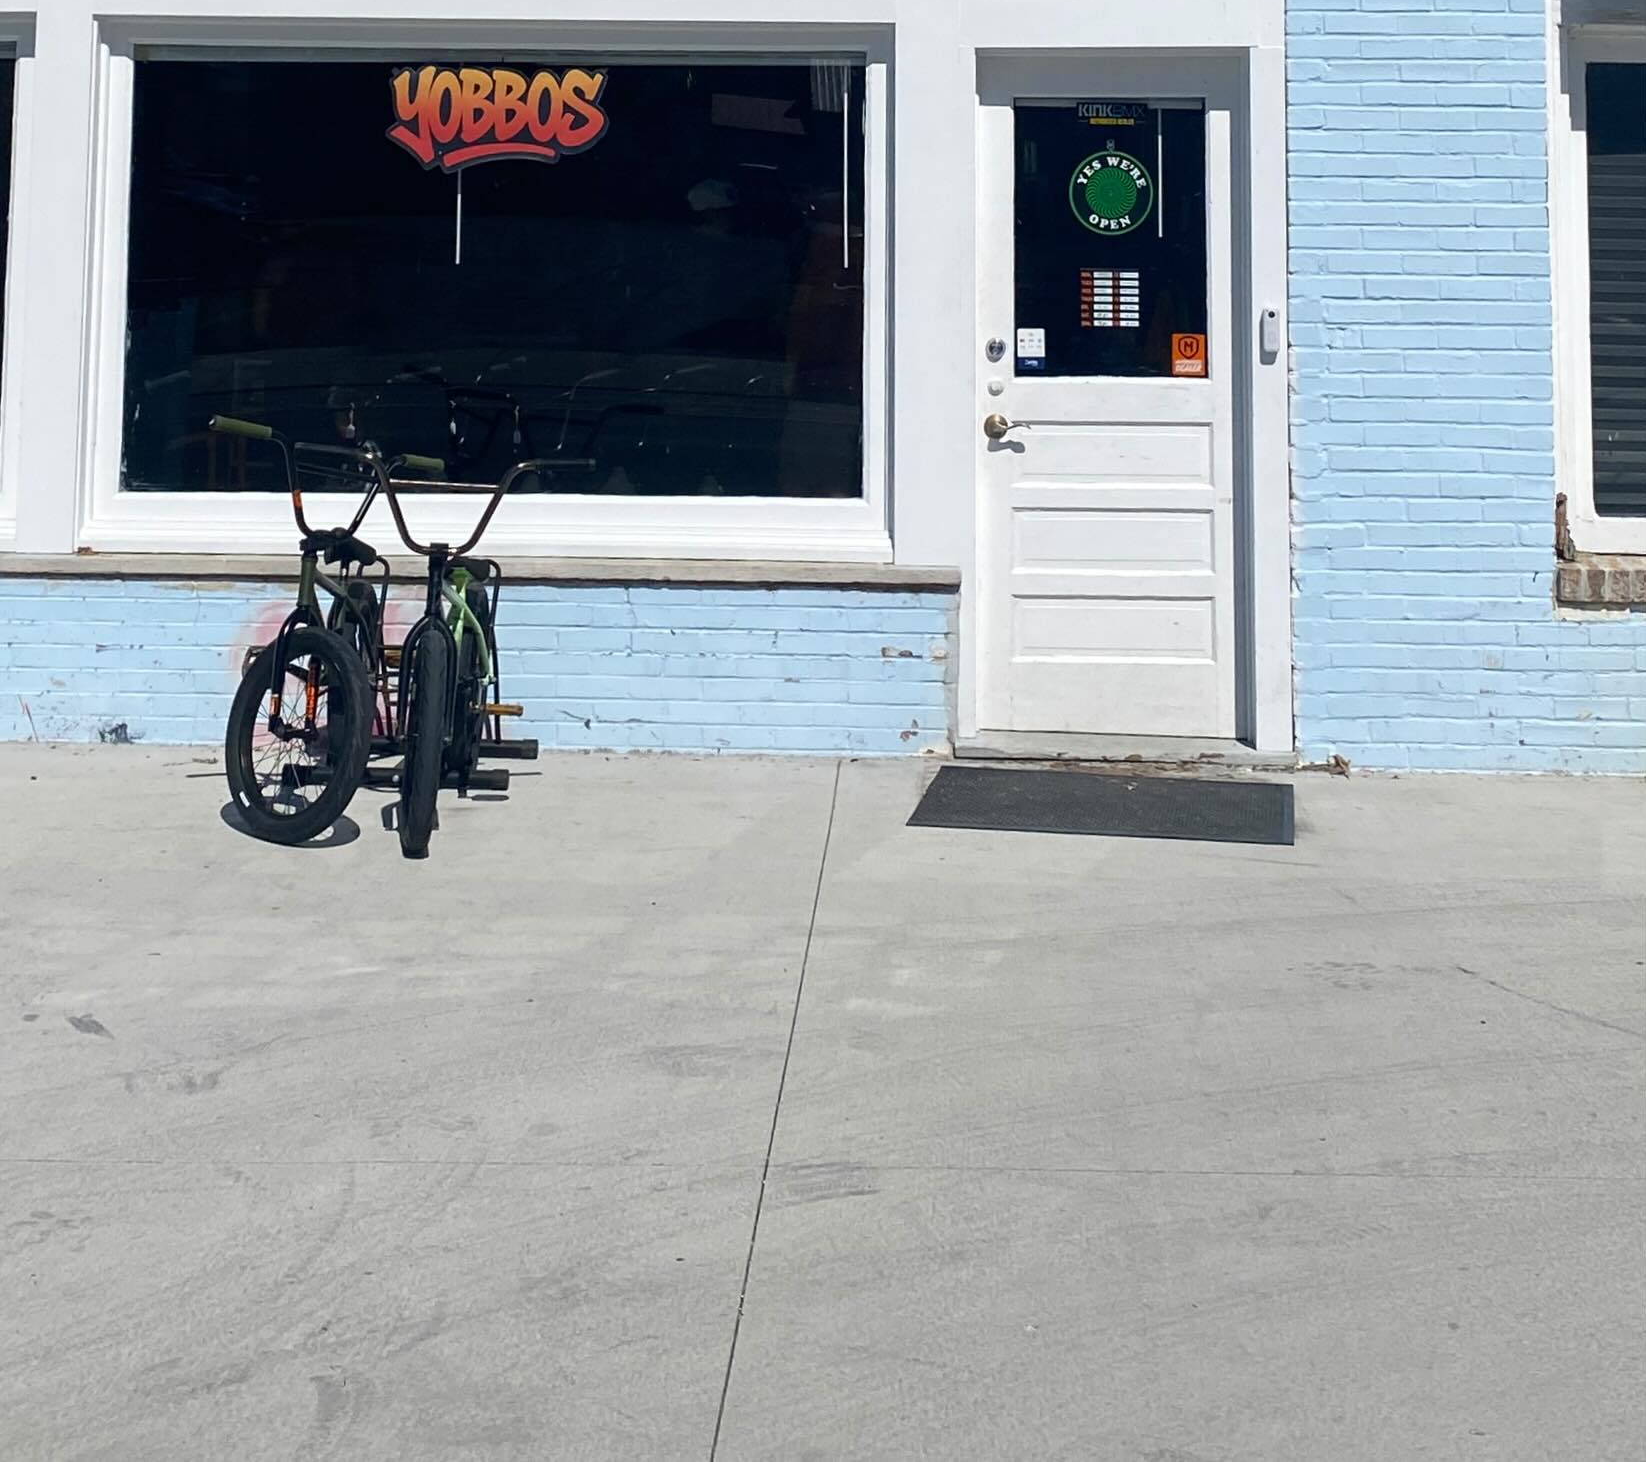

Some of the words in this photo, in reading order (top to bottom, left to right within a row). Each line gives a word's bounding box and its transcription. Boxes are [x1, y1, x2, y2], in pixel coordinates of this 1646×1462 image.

[388, 66, 605, 164] YOBBOS
[1077, 160, 1102, 184] YES
[1106, 156, 1147, 188] WE'RE
[1088, 214, 1131, 230] OPEN
